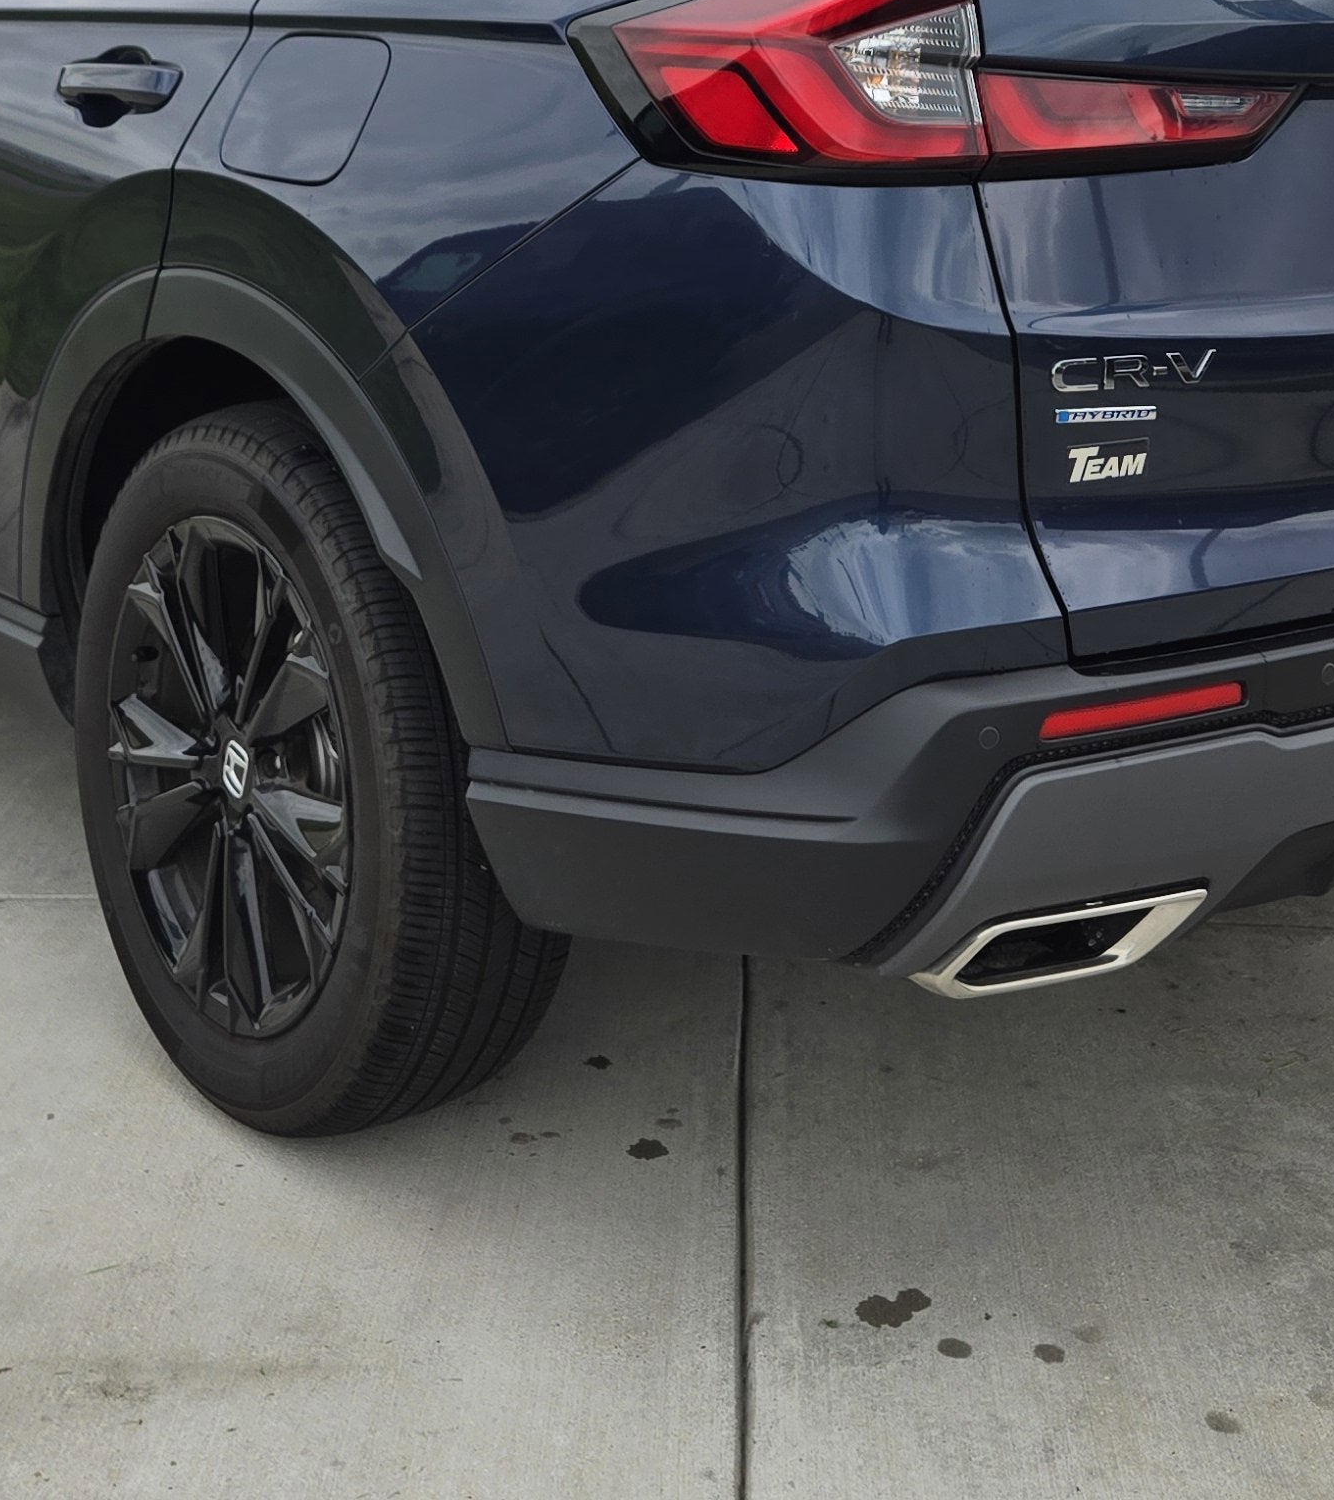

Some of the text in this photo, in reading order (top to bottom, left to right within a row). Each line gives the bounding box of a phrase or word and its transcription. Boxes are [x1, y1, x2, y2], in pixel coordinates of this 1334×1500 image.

[1051, 348, 1217, 392] CR-V
[1071, 410, 1151, 421] HYBRID
[1068, 446, 1148, 483] TEAM
